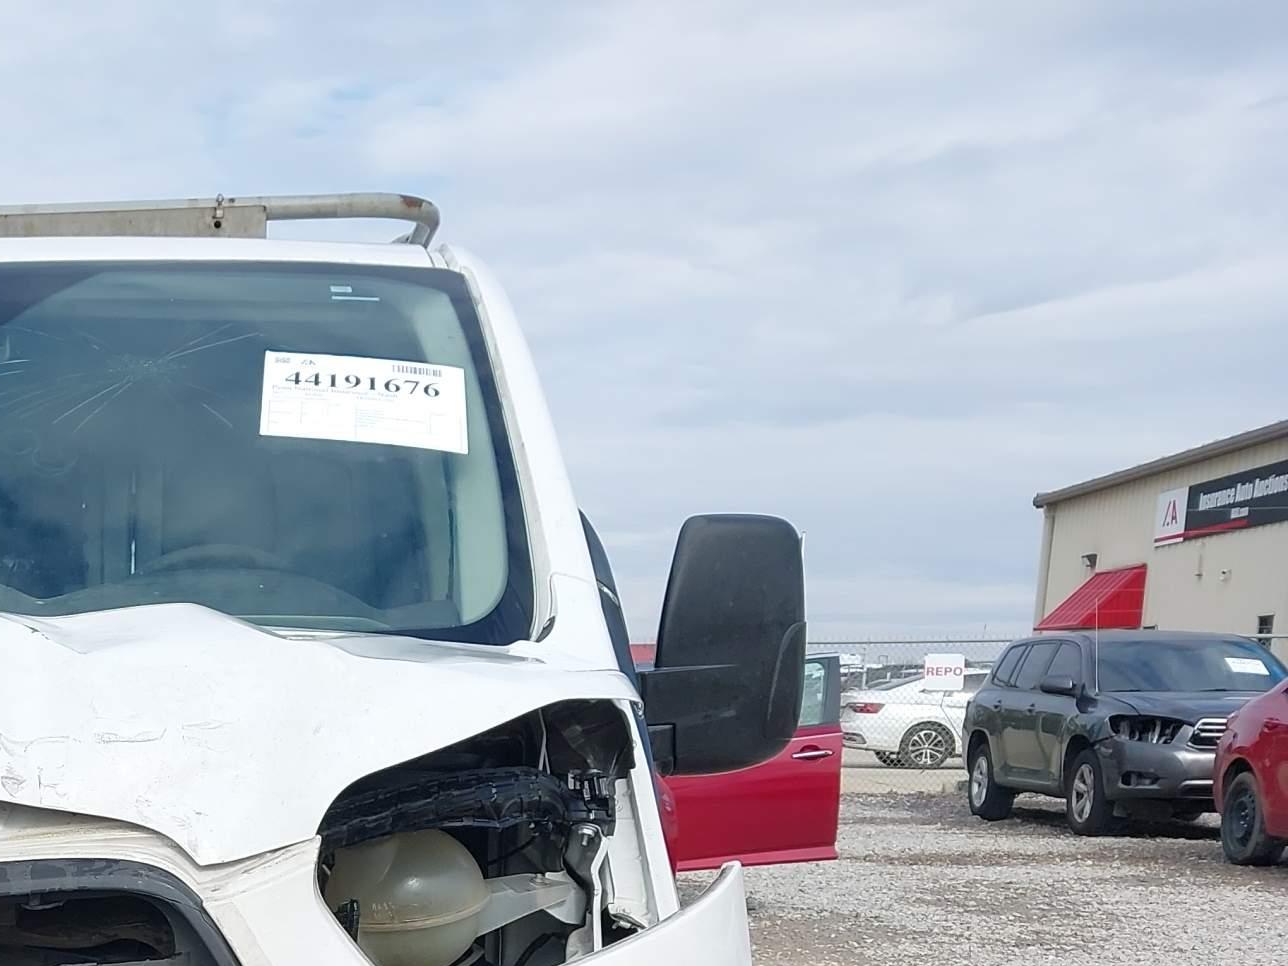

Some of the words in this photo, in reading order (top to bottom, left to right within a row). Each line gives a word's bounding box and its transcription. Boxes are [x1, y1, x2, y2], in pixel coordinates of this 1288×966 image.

[284, 371, 441, 398] 44191676
[1198, 488, 1235, 511] Insurance
[1235, 482, 1253, 502] Auto
[926, 666, 963, 677] REPO
